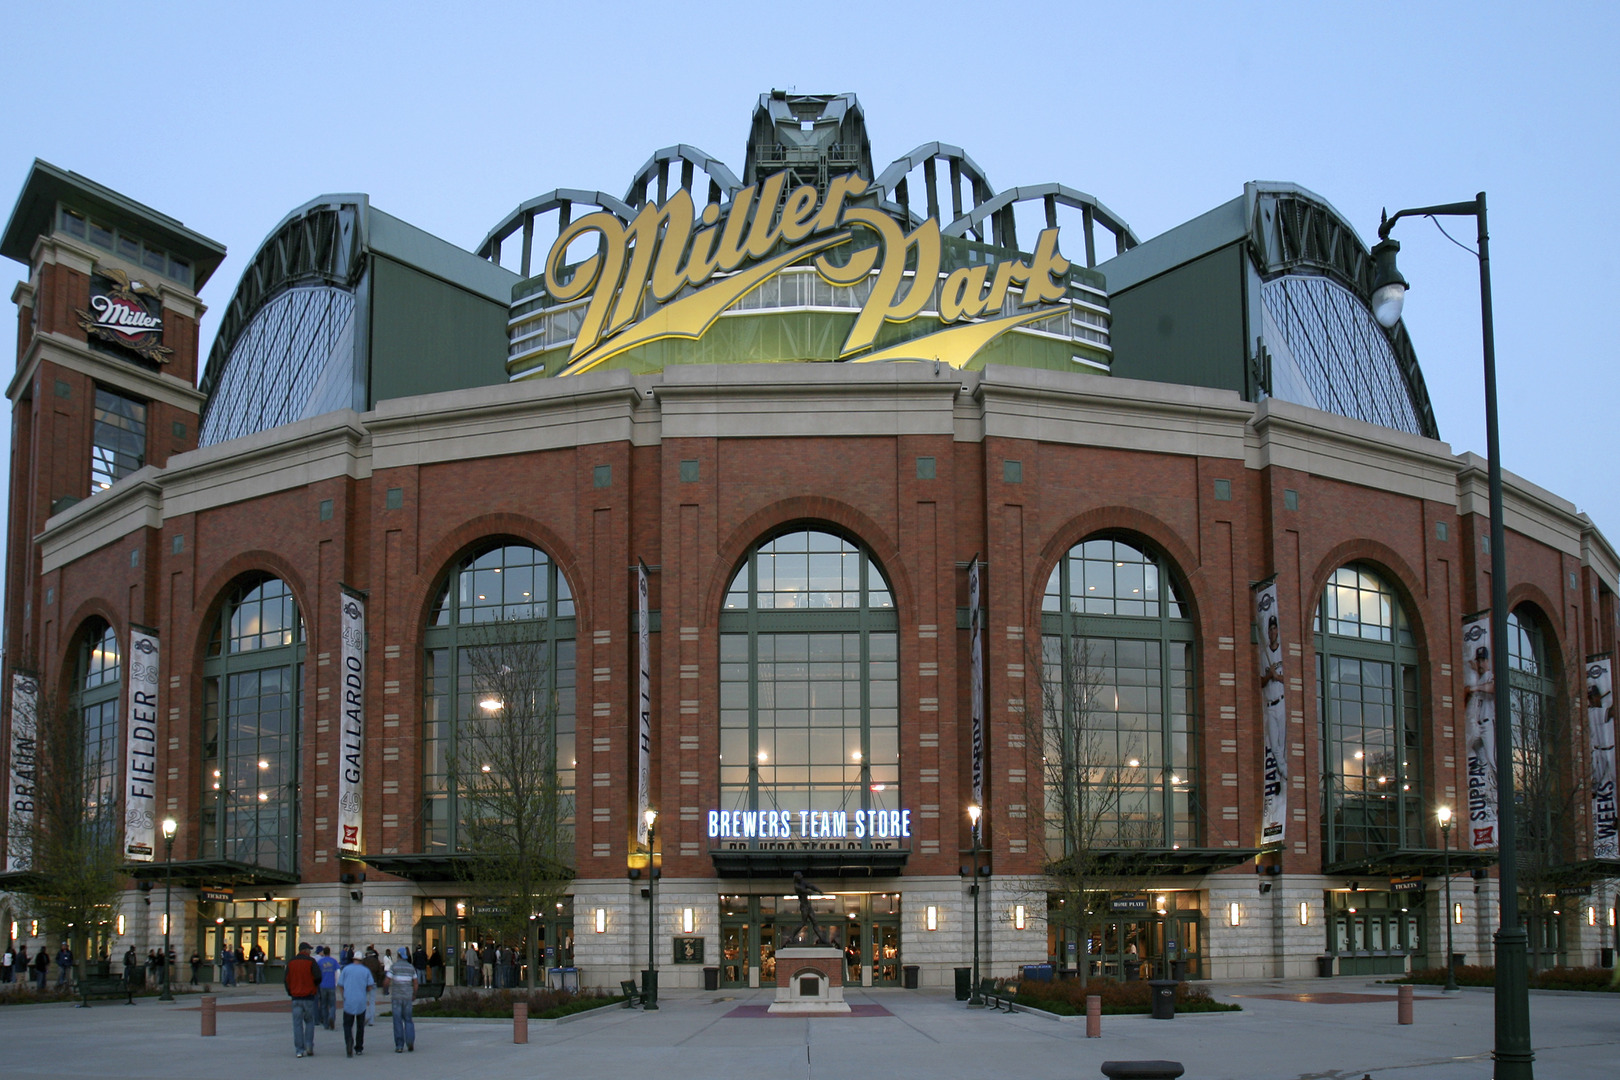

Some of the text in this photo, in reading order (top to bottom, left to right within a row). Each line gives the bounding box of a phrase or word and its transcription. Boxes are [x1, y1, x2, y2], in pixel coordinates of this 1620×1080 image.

[545, 169, 1071, 365] Miller Park
[91, 295, 161, 327] Miller
[342, 627, 362, 650] 49
[131, 662, 158, 684] 28
[345, 656, 361, 784] GALLARDO
[131, 691, 156, 799] FIELDER
[1265, 746, 1280, 796] HART
[341, 791, 362, 813] 49
[1468, 756, 1487, 821] SUPPAN
[127, 808, 155, 829] 28
[708, 809, 911, 838] BREWERS TEAM STORE
[1597, 781, 1616, 840] WEEKS
[1395, 882, 1417, 890] TICKETS
